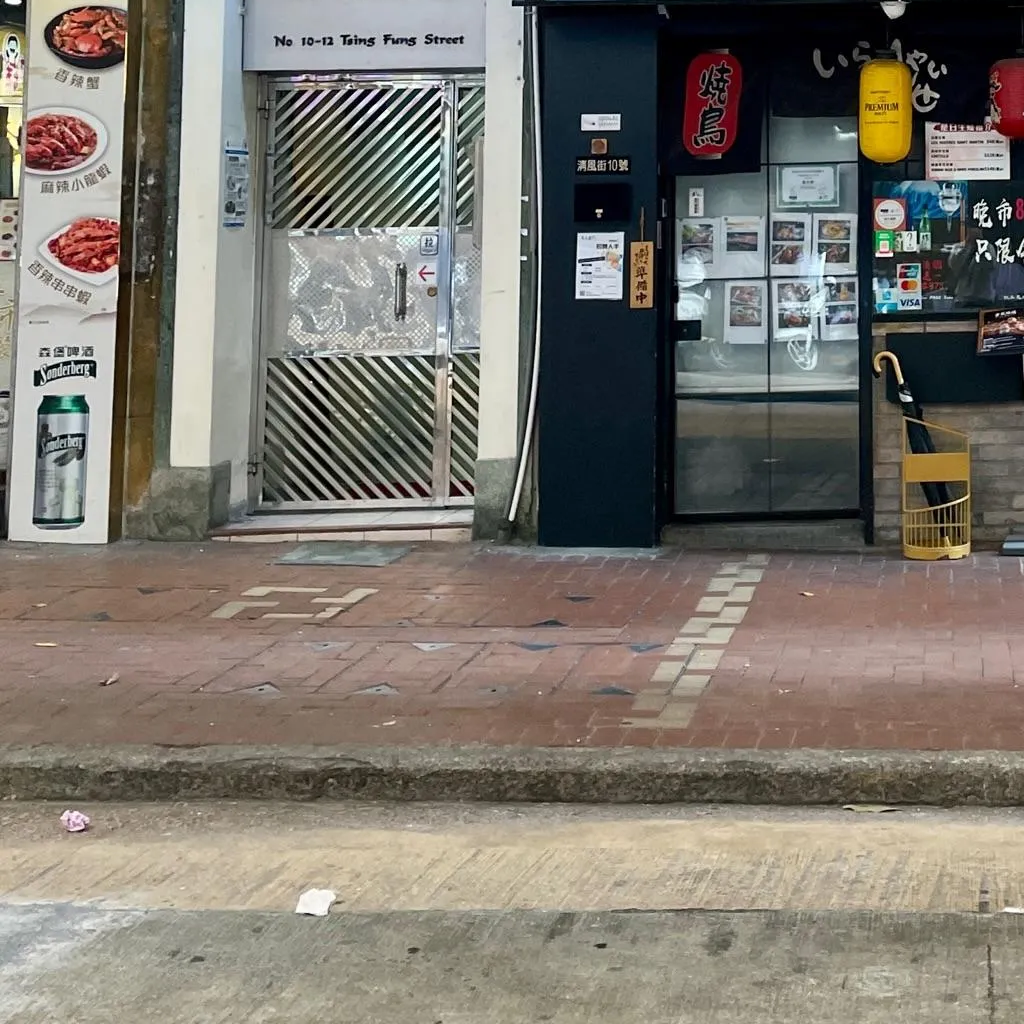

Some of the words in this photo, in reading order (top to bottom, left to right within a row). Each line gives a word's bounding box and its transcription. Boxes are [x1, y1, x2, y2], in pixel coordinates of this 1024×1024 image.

[273, 35, 293, 47] No
[301, 36, 334, 46] 10-12
[340, 34, 376, 48] Tsing
[382, 34, 417, 47] Fung
[424, 34, 465, 45] Street
[54, 67, 100, 90] 香辣蟹
[864, 102, 899, 111] PREMIUM
[40, 163, 112, 194] 麻辣小龍蝦
[27, 260, 92, 306] 香辣串串蝦
[900, 299, 921, 307] VISA
[39, 346, 94, 358] 森堡啤酒
[39, 360, 91, 386] Sonderberg
